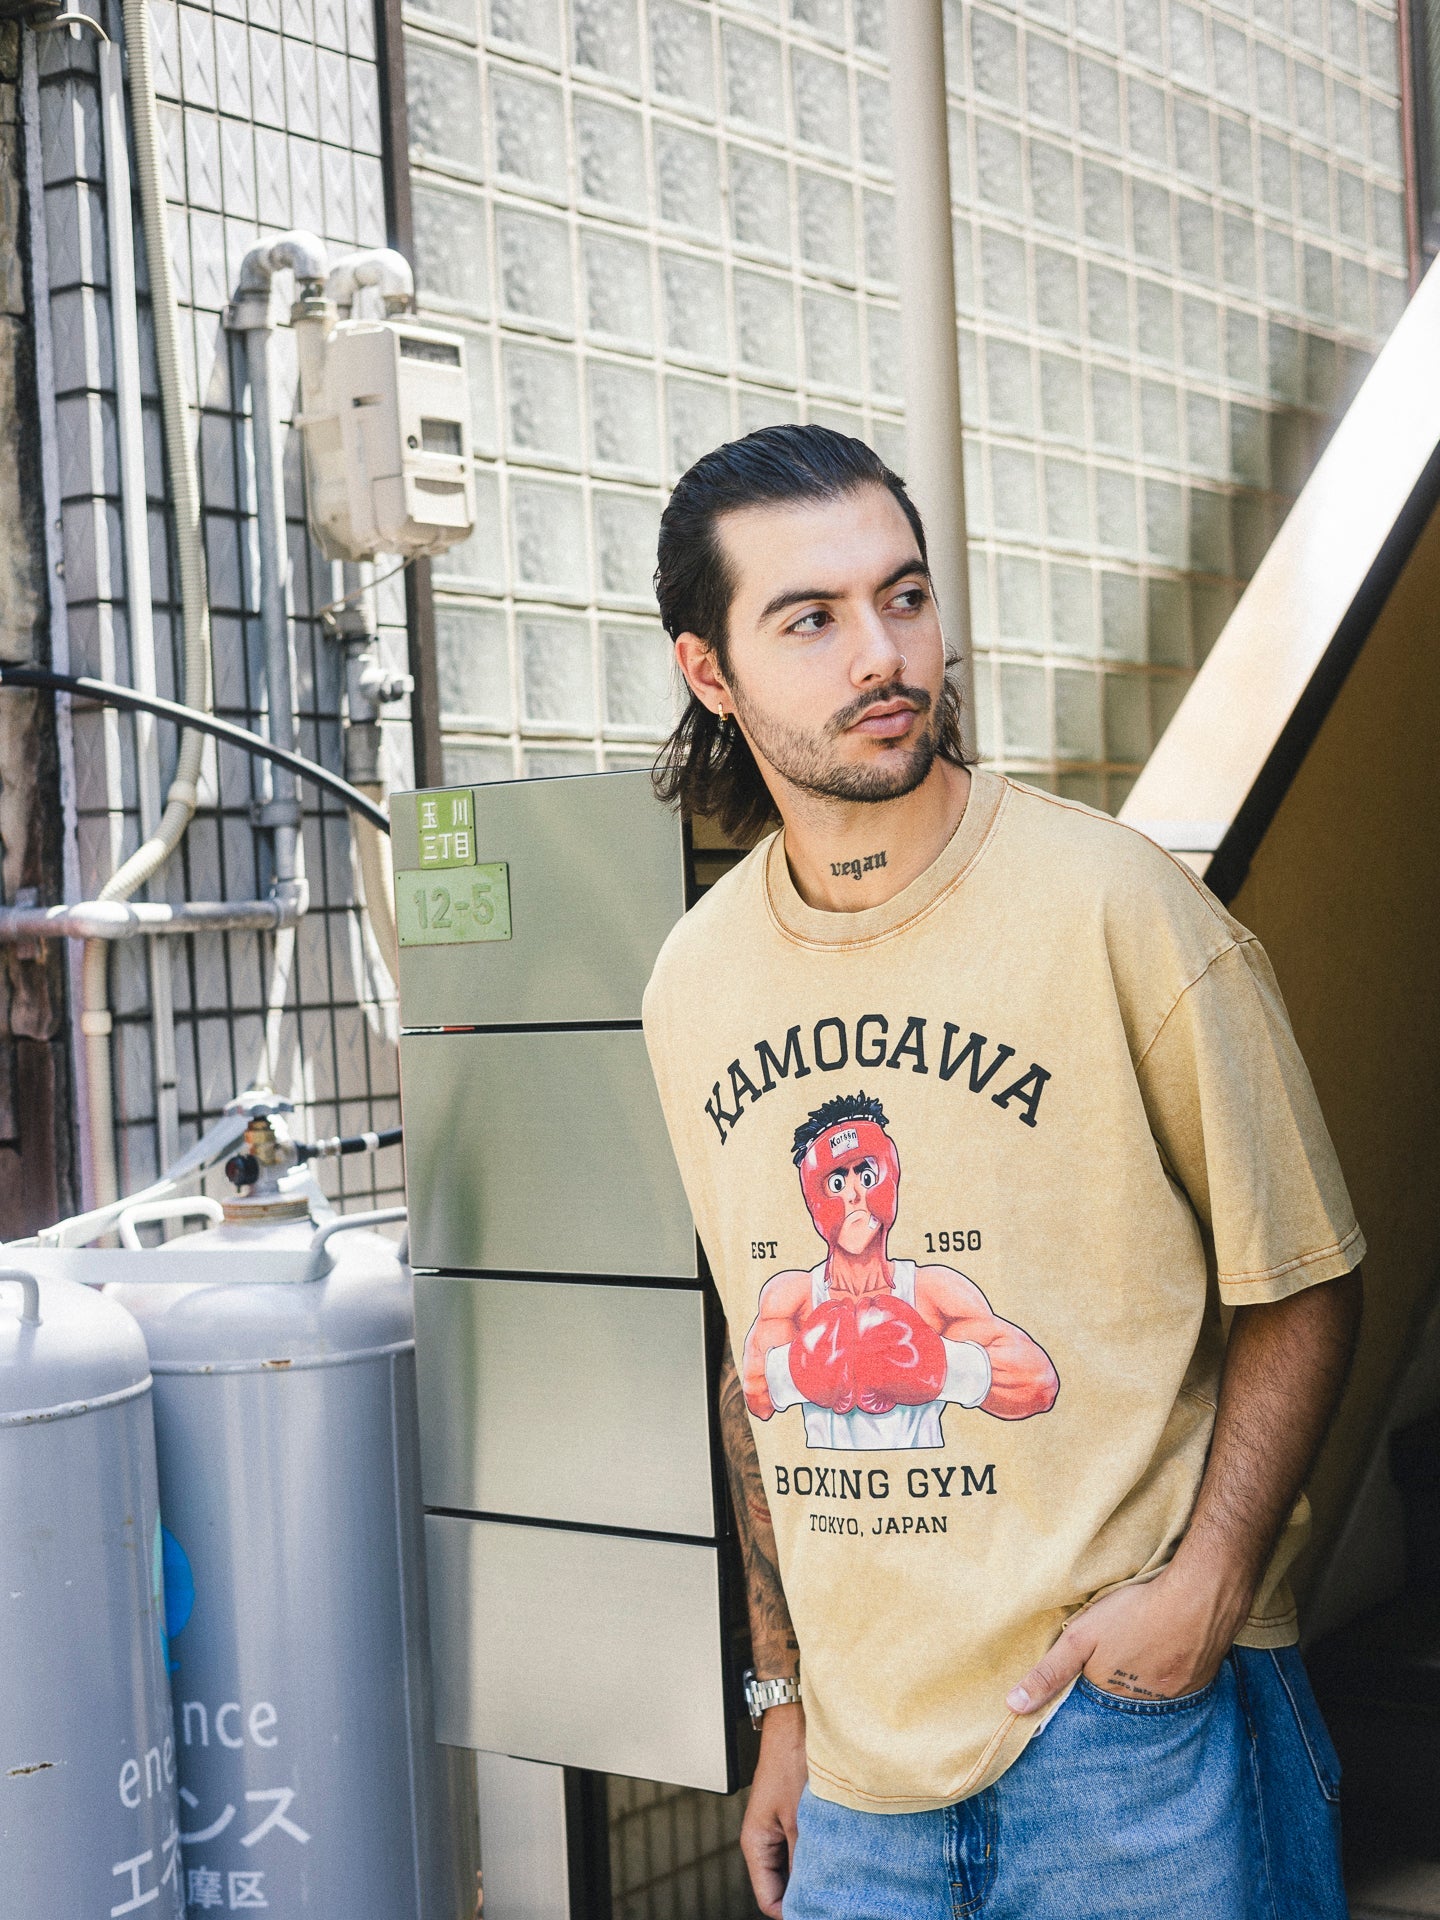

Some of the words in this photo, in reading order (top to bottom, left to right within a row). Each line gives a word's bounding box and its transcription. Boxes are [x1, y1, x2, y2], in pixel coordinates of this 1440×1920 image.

[422, 799, 468, 829] 玉川
[423, 832, 470, 860] 三丁目
[830, 850, 887, 880] vegan
[413, 882, 495, 930] 12-5
[704, 1013, 1052, 1146] KAMOGAWA
[751, 1241, 778, 1260] EST
[924, 1229, 982, 1253] 1950
[775, 1465, 889, 1499] BOXING
[907, 1464, 997, 1498] GYM
[810, 1514, 864, 1537] TOKYO,
[872, 1516, 947, 1535] JAPAN
[182, 1701, 278, 1748] nce
